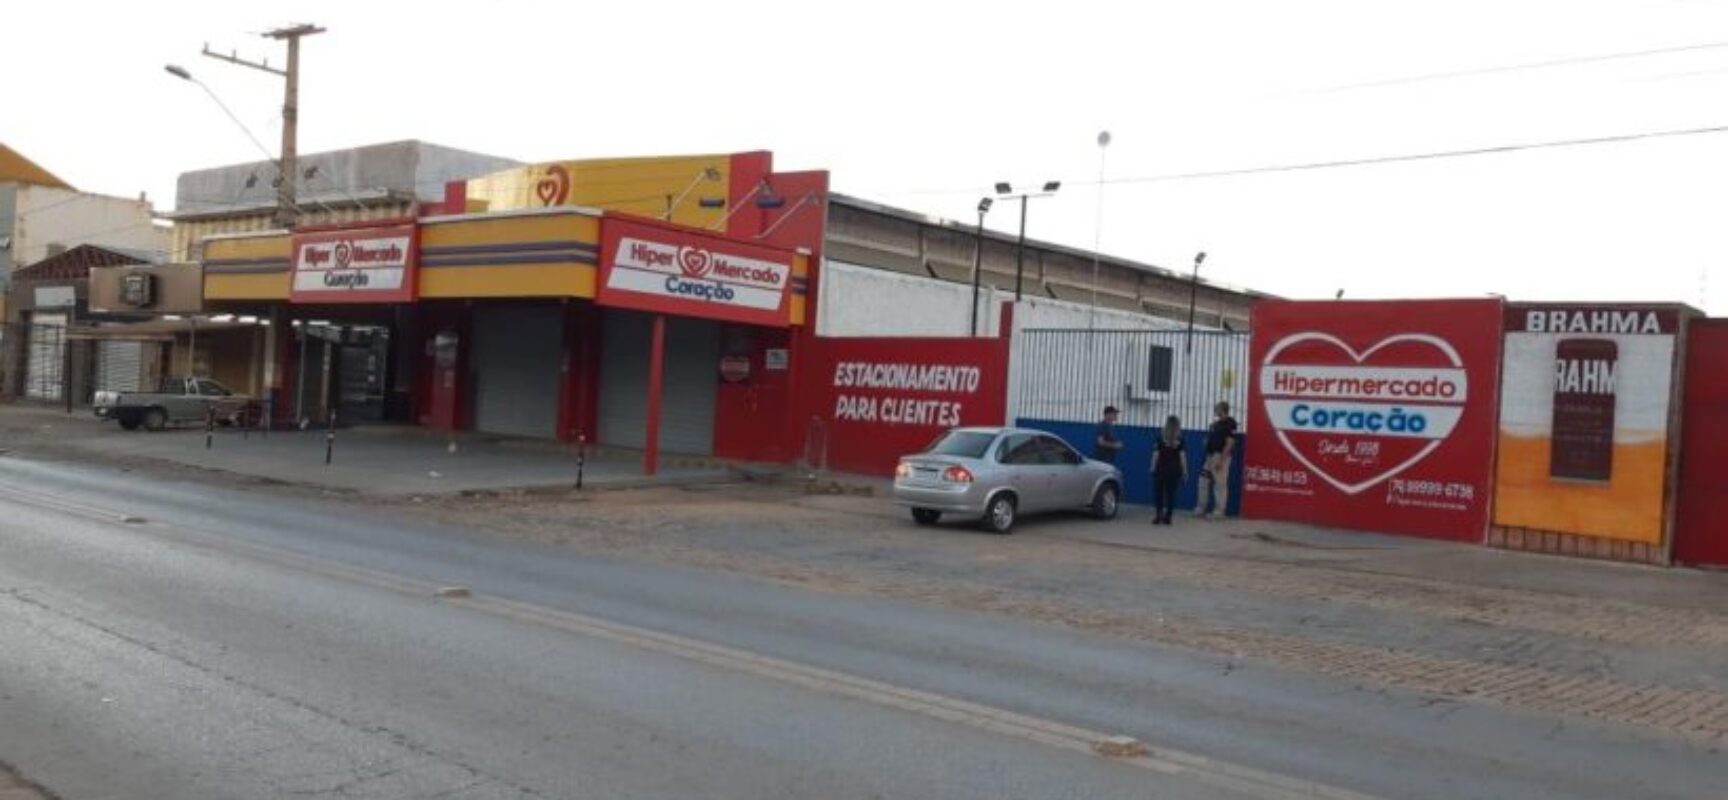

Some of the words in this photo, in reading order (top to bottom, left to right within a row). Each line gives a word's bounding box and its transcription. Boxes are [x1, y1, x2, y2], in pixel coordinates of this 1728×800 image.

[631, 243, 675, 267] Hiper
[714, 259, 780, 284] Mercado
[665, 276, 734, 301] Coração
[1527, 310, 1661, 334] BRAHMA
[834, 361, 980, 393] ESTACIONAMENTO
[1274, 371, 1456, 397] Hipermercado
[835, 395, 878, 421] PARA
[880, 397, 961, 426] CLIENTES
[1291, 404, 1426, 433] Coração
